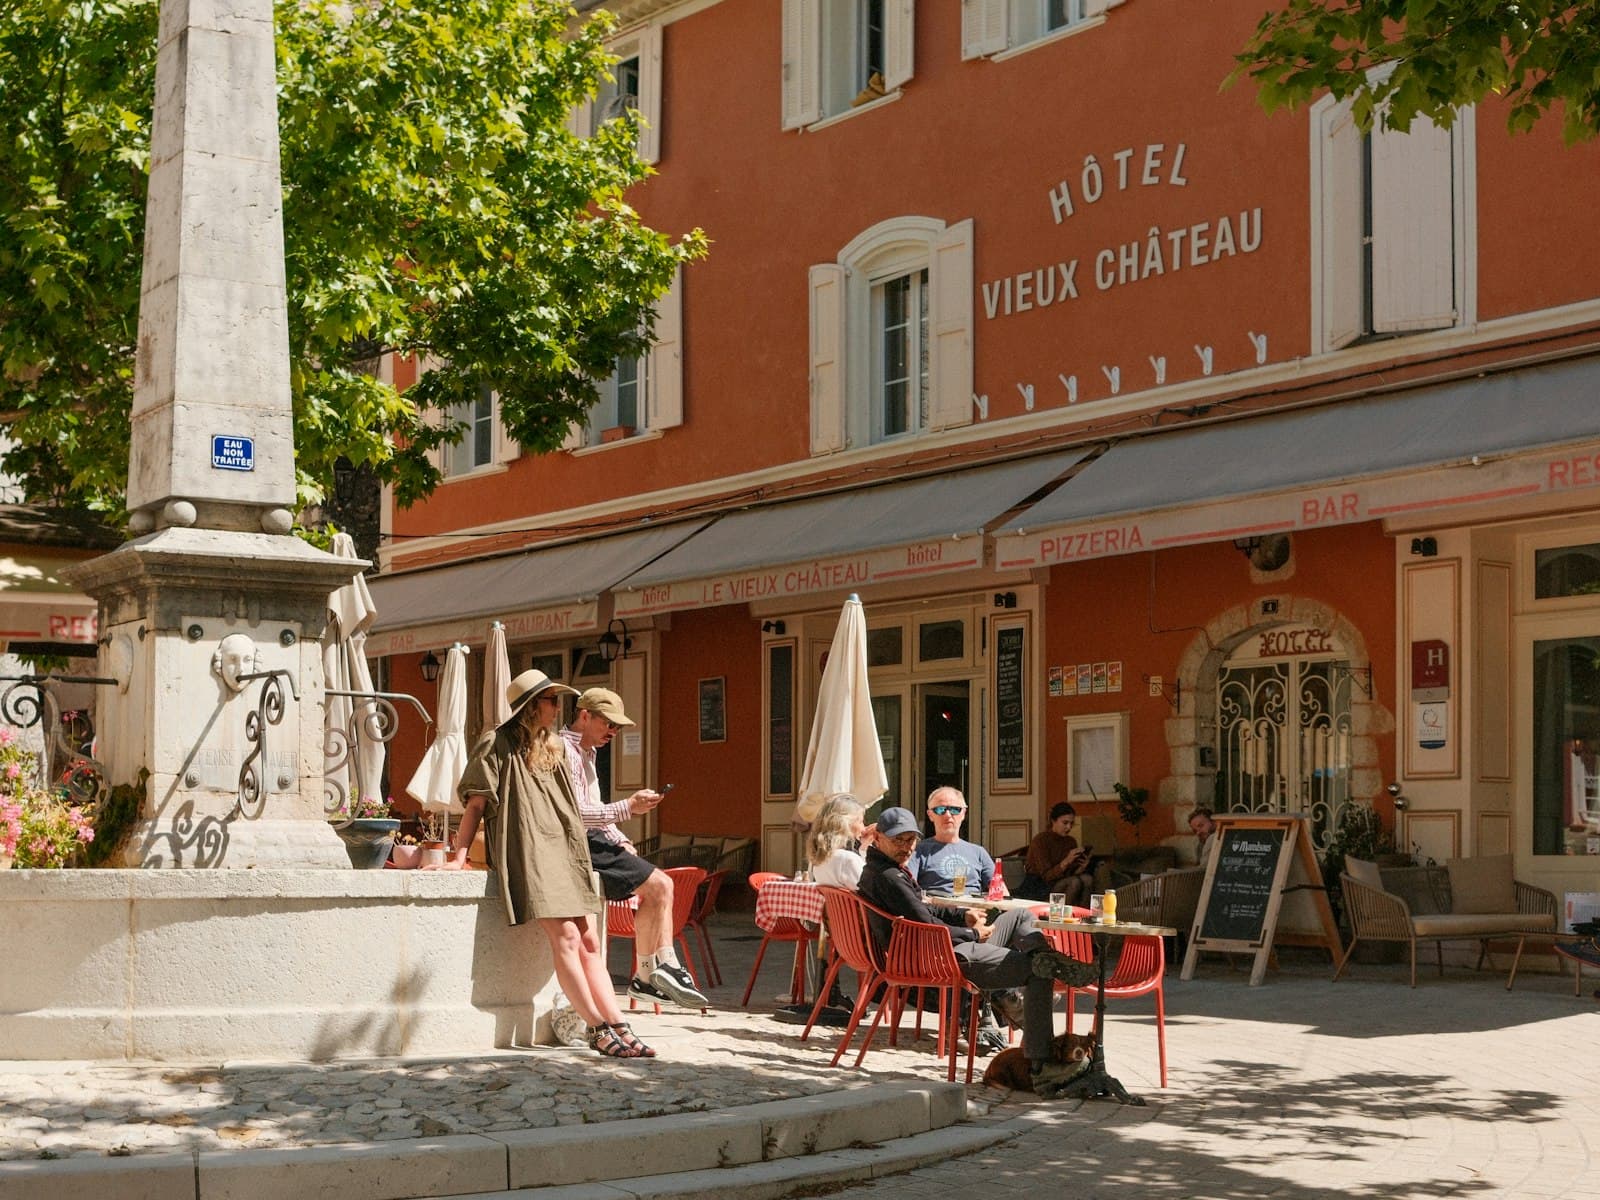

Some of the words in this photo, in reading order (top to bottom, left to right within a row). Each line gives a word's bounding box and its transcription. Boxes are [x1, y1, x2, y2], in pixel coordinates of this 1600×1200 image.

[1049, 143, 1187, 225] HÔTEL
[982, 259, 1079, 320] VIEUX
[1095, 207, 1263, 290] CHÂTEAU
[223, 440, 243, 449] EAU
[223, 448, 244, 457] NON
[214, 455, 253, 467] TRAITÉE
[1039, 525, 1145, 562] PIZZERIA
[1302, 491, 1361, 526] BAR
[702, 583, 723, 603] LE
[729, 573, 778, 600] VIEUX
[784, 561, 868, 593] CHÂTEAU
[906, 543, 943, 566] hôtel
[487, 610, 573, 640] RSTAURANT
[1259, 629, 1334, 657] HOTEL
[1427, 647, 1445, 667] H
